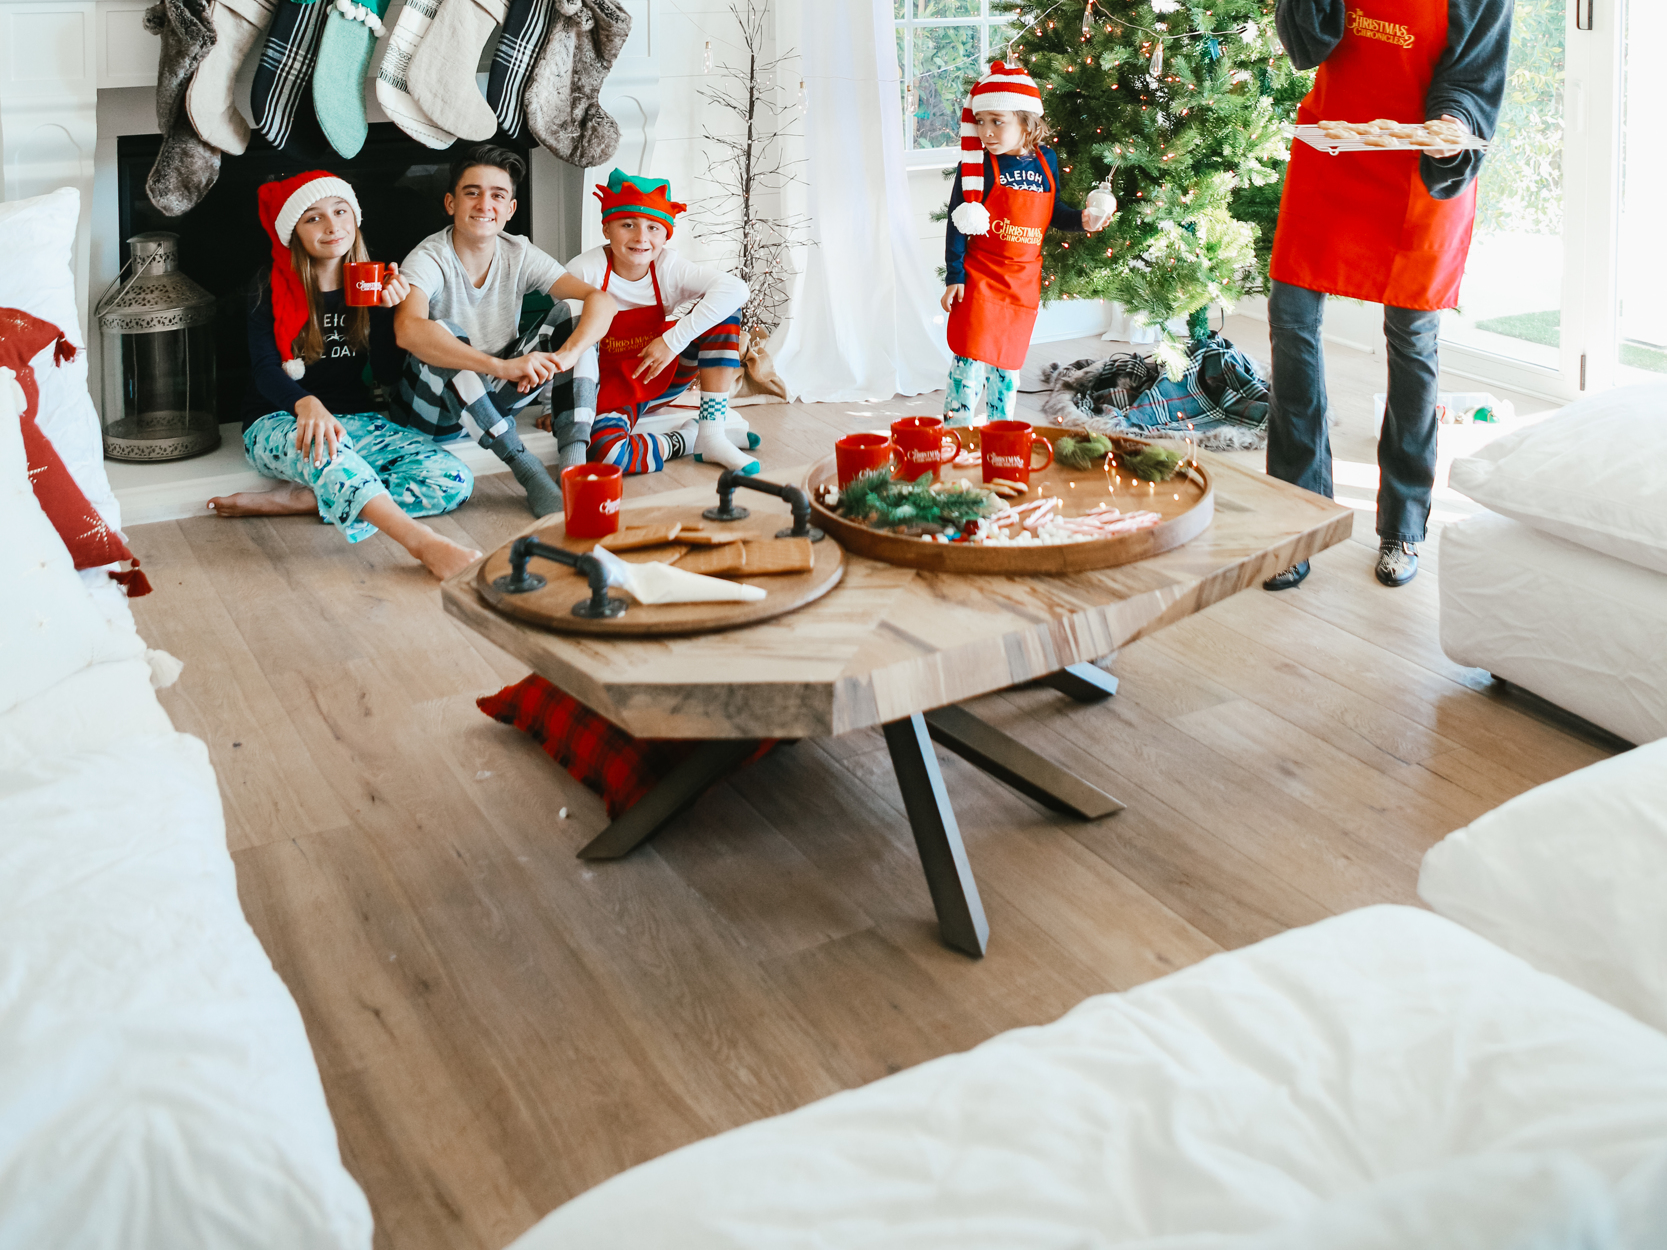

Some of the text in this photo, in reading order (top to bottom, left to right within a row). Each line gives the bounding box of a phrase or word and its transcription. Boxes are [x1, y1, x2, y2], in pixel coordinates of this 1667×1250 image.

[1345, 11, 1408, 37] CHRISTMAS
[1353, 27, 1404, 46] CHRONICLES
[999, 170, 1042, 184] SLEIGH
[991, 219, 1042, 238] CHRISTMAS
